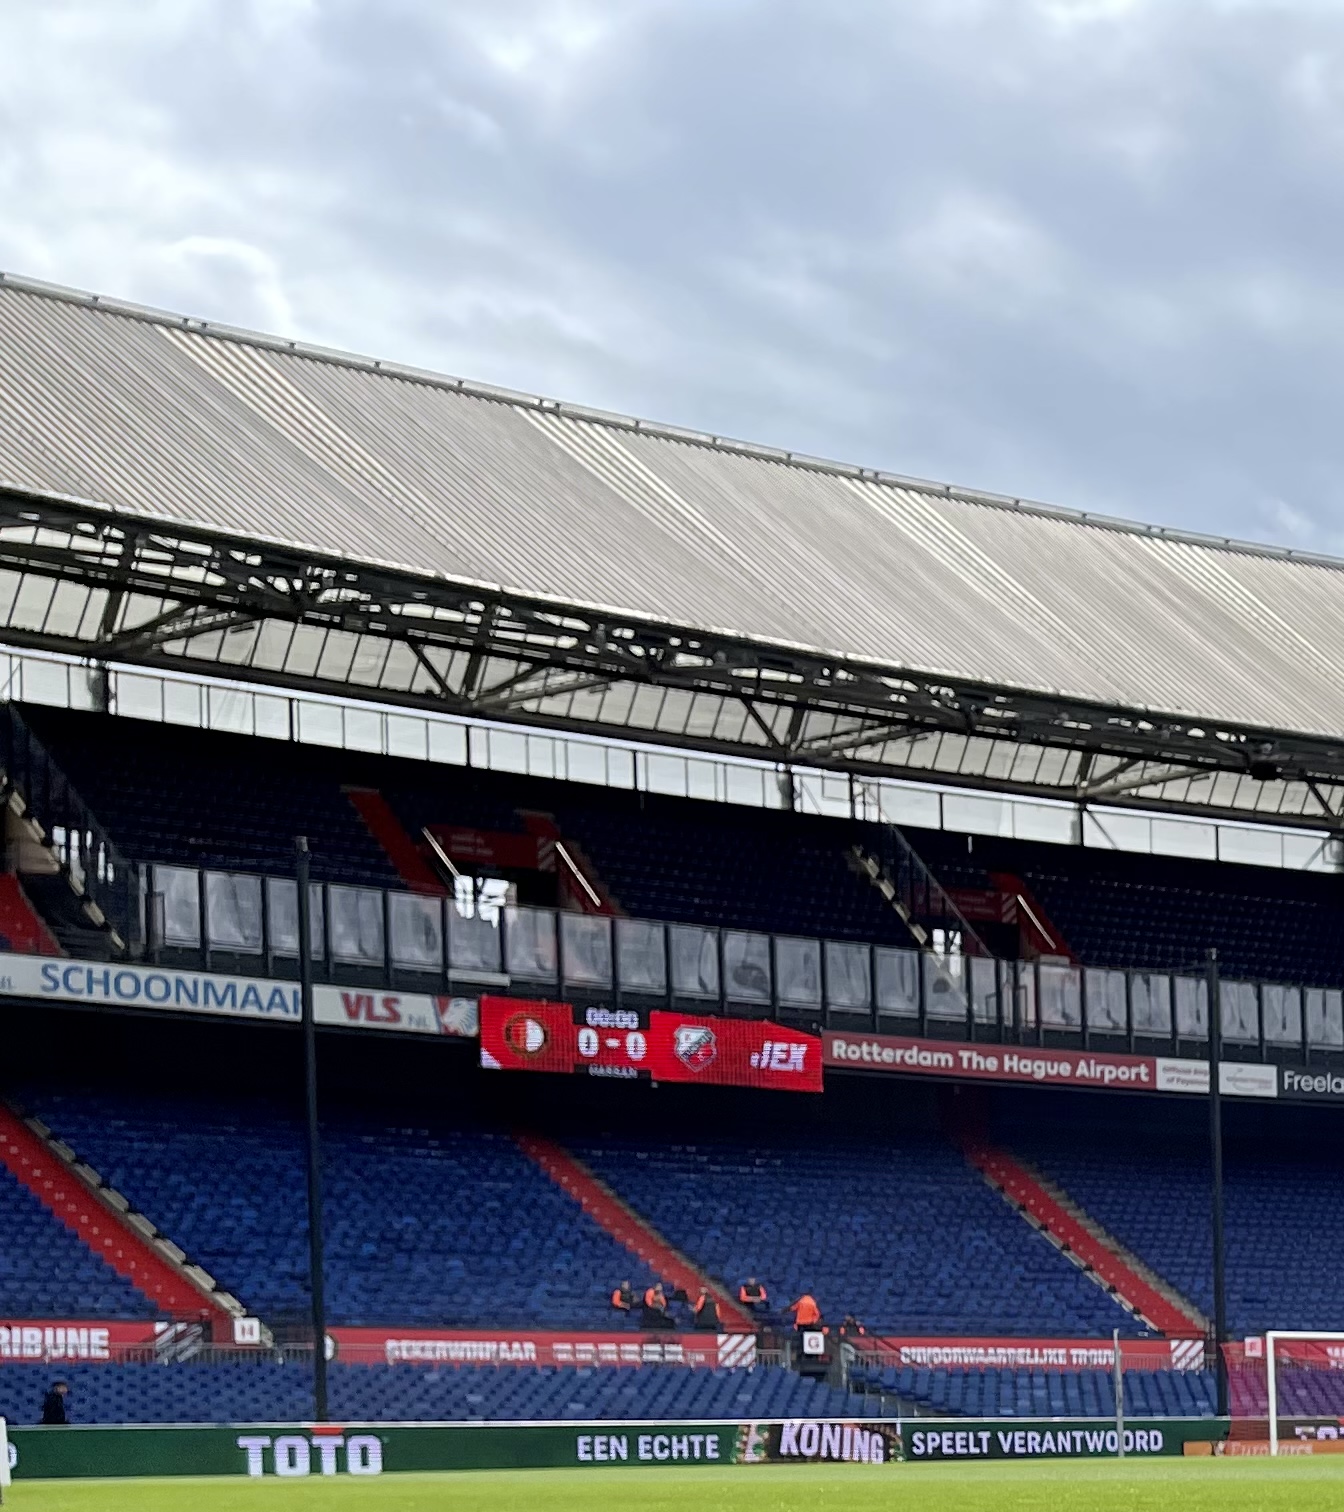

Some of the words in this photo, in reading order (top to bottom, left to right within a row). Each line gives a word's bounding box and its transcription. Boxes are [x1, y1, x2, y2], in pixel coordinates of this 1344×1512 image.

[41, 963, 300, 1017] SCHOONMAA
[341, 992, 401, 1023] VLS
[832, 1039, 954, 1068] Rotterdam
[958, 1049, 999, 1071] The
[1003, 1054, 1072, 1080] Hague
[1075, 1060, 1150, 1084] Airport
[237, 1435, 383, 1476] TOTO
[577, 1434, 628, 1461] EEN
[637, 1434, 720, 1461] ECHTE
[779, 1422, 885, 1464] KONING
[911, 1431, 991, 1455] SPEELT
[997, 1430, 1164, 1454] VERANTWOORD
